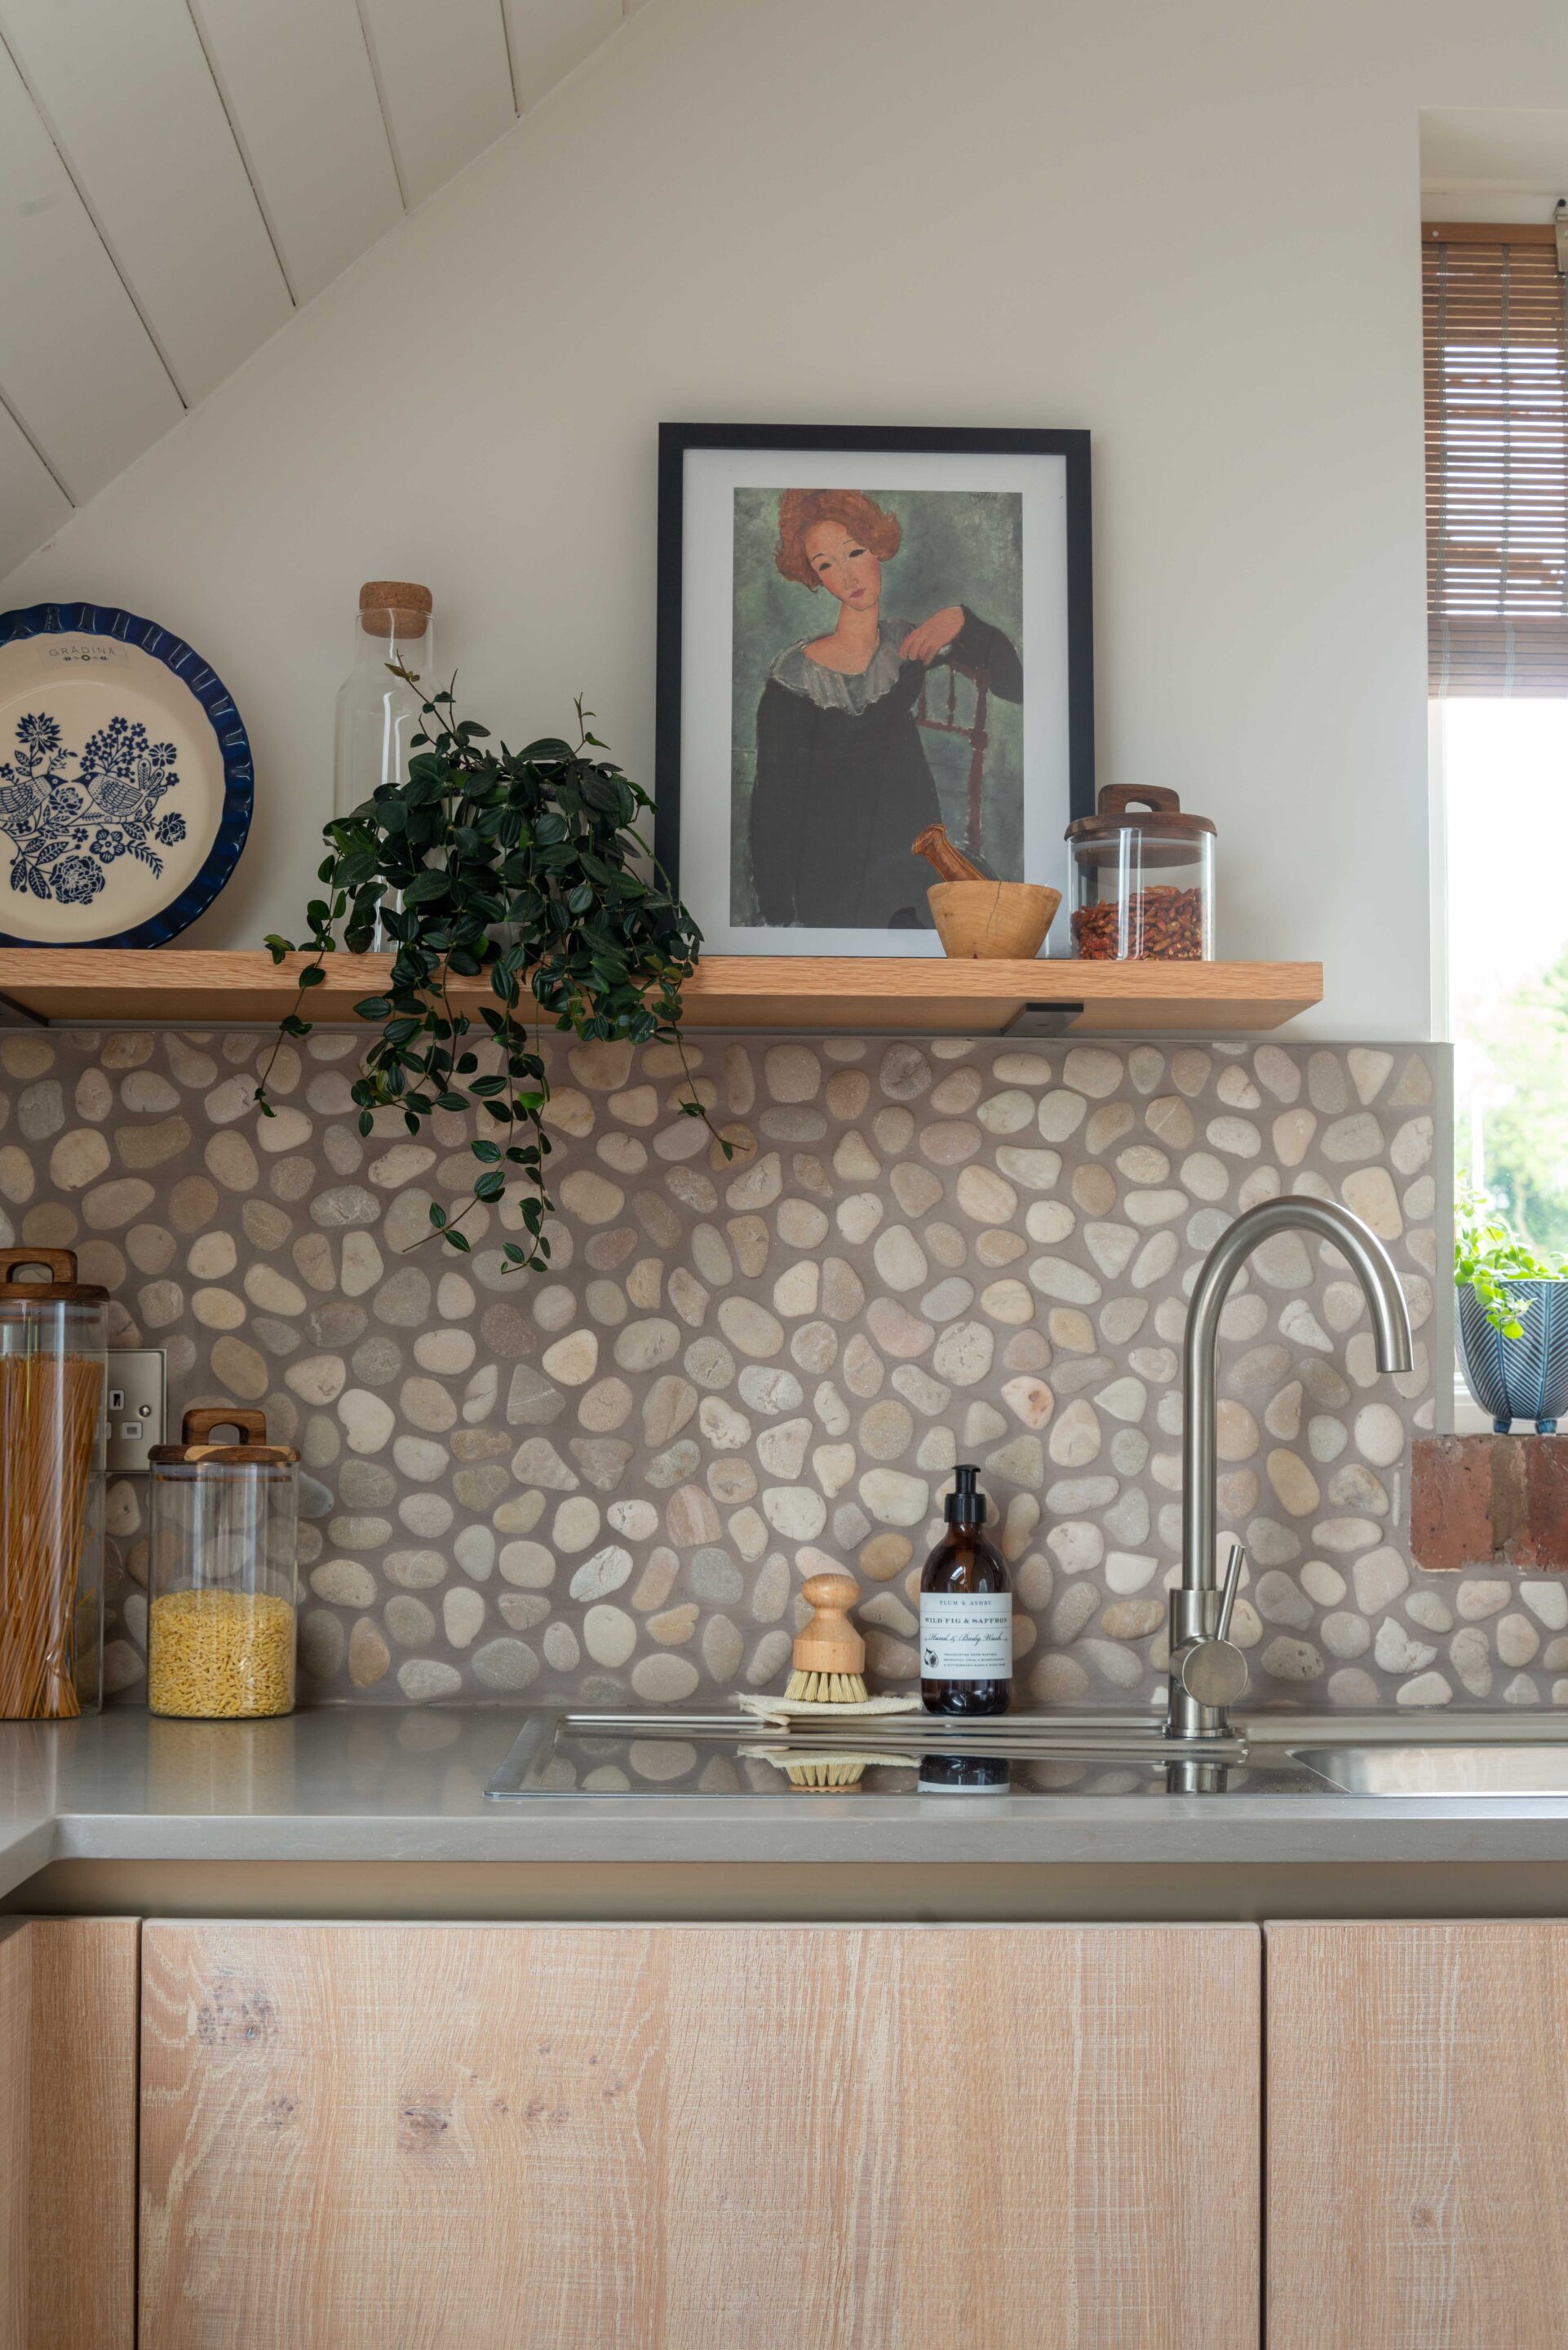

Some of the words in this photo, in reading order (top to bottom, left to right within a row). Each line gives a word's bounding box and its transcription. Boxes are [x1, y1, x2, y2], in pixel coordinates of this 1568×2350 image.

[928, 1633, 949, 1641] Hand
[959, 1632, 981, 1646] Body
[984, 1631, 1003, 1641] Wash
